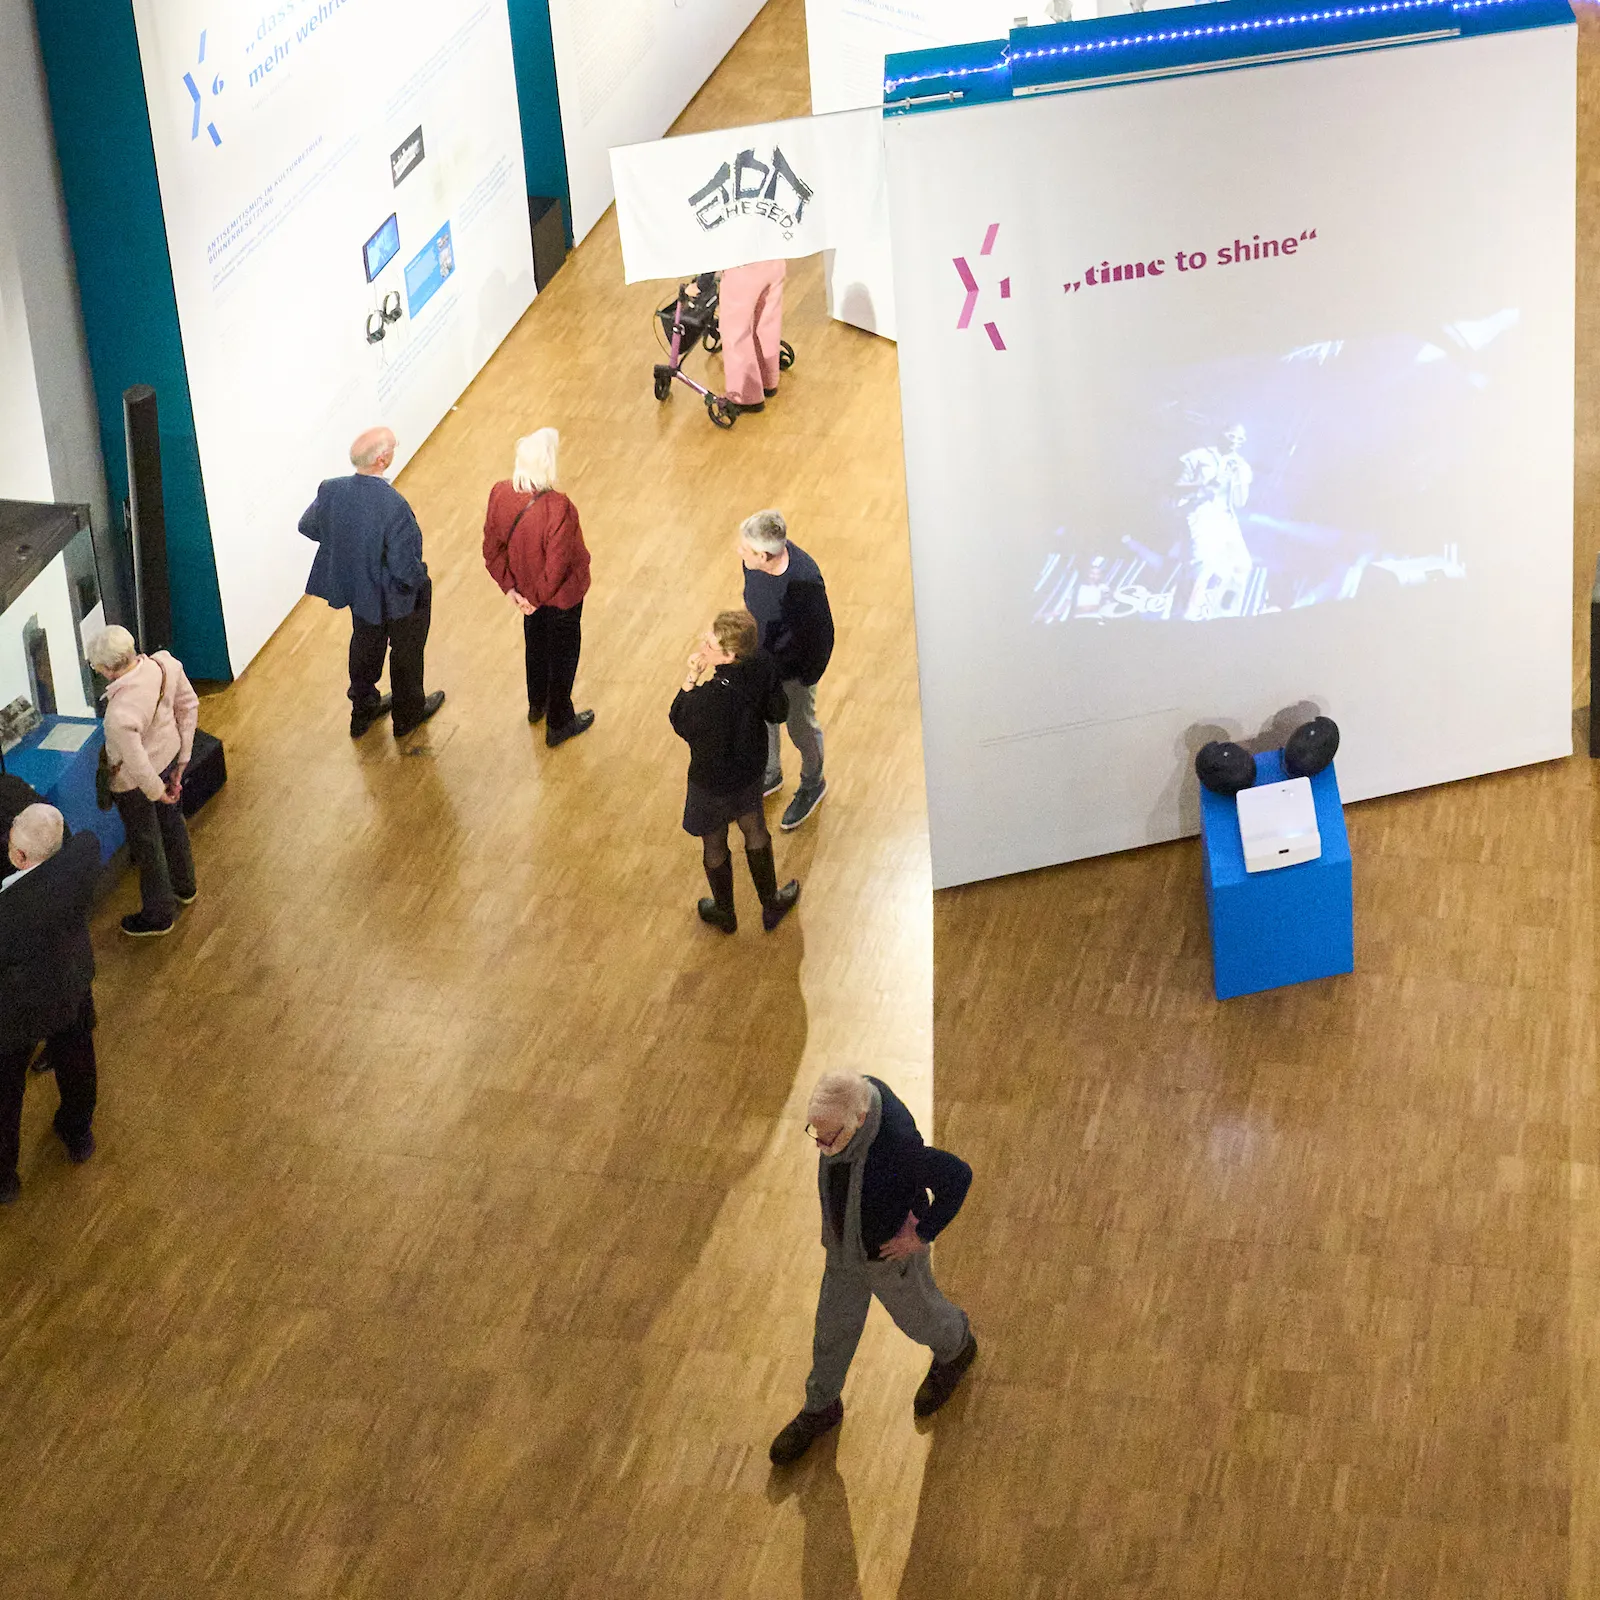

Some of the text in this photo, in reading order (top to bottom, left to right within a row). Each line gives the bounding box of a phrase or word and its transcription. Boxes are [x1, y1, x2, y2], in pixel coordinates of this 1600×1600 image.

[212, 72, 224, 95] 6
[249, 37, 290, 87] mehr
[207, 192, 263, 254] ANTISEMITISMUS
[696, 195, 794, 232] CHESED
[1062, 228, 1317, 294] „time to shine“
[998, 276, 1011, 299] 1
